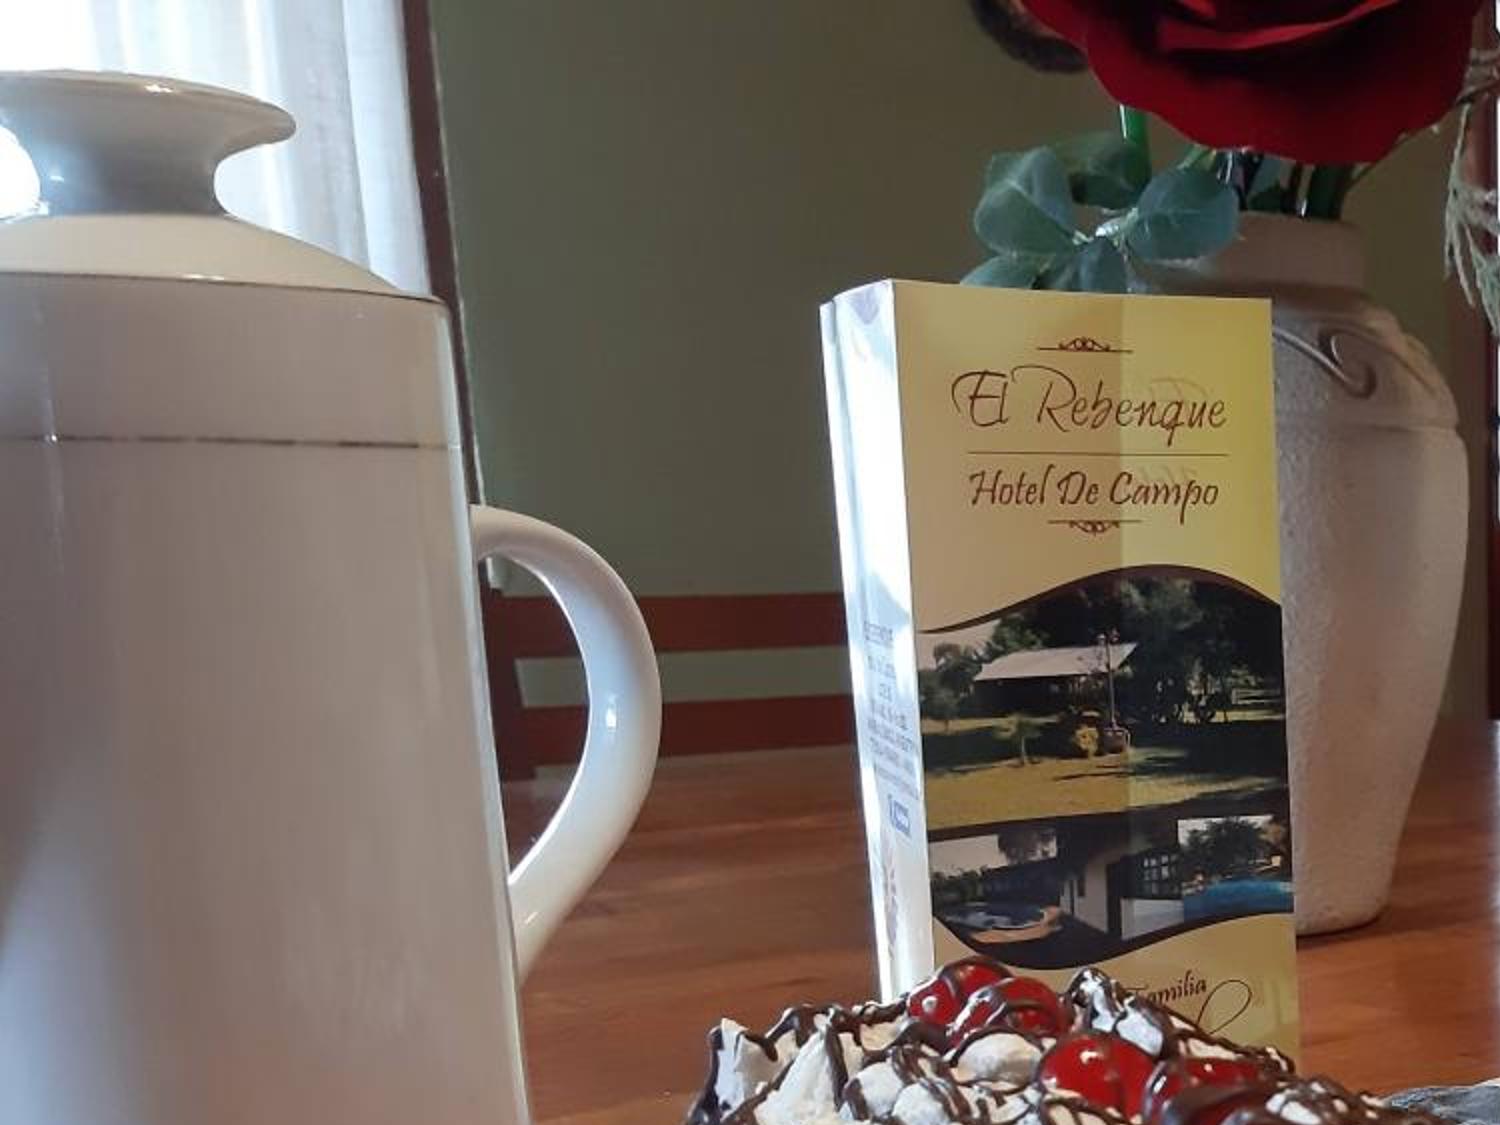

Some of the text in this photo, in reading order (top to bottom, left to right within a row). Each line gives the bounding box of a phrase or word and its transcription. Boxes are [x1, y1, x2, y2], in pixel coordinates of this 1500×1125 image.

[951, 364, 1228, 446] El Rebenque
[969, 464, 1219, 524] Hotel De Campo
